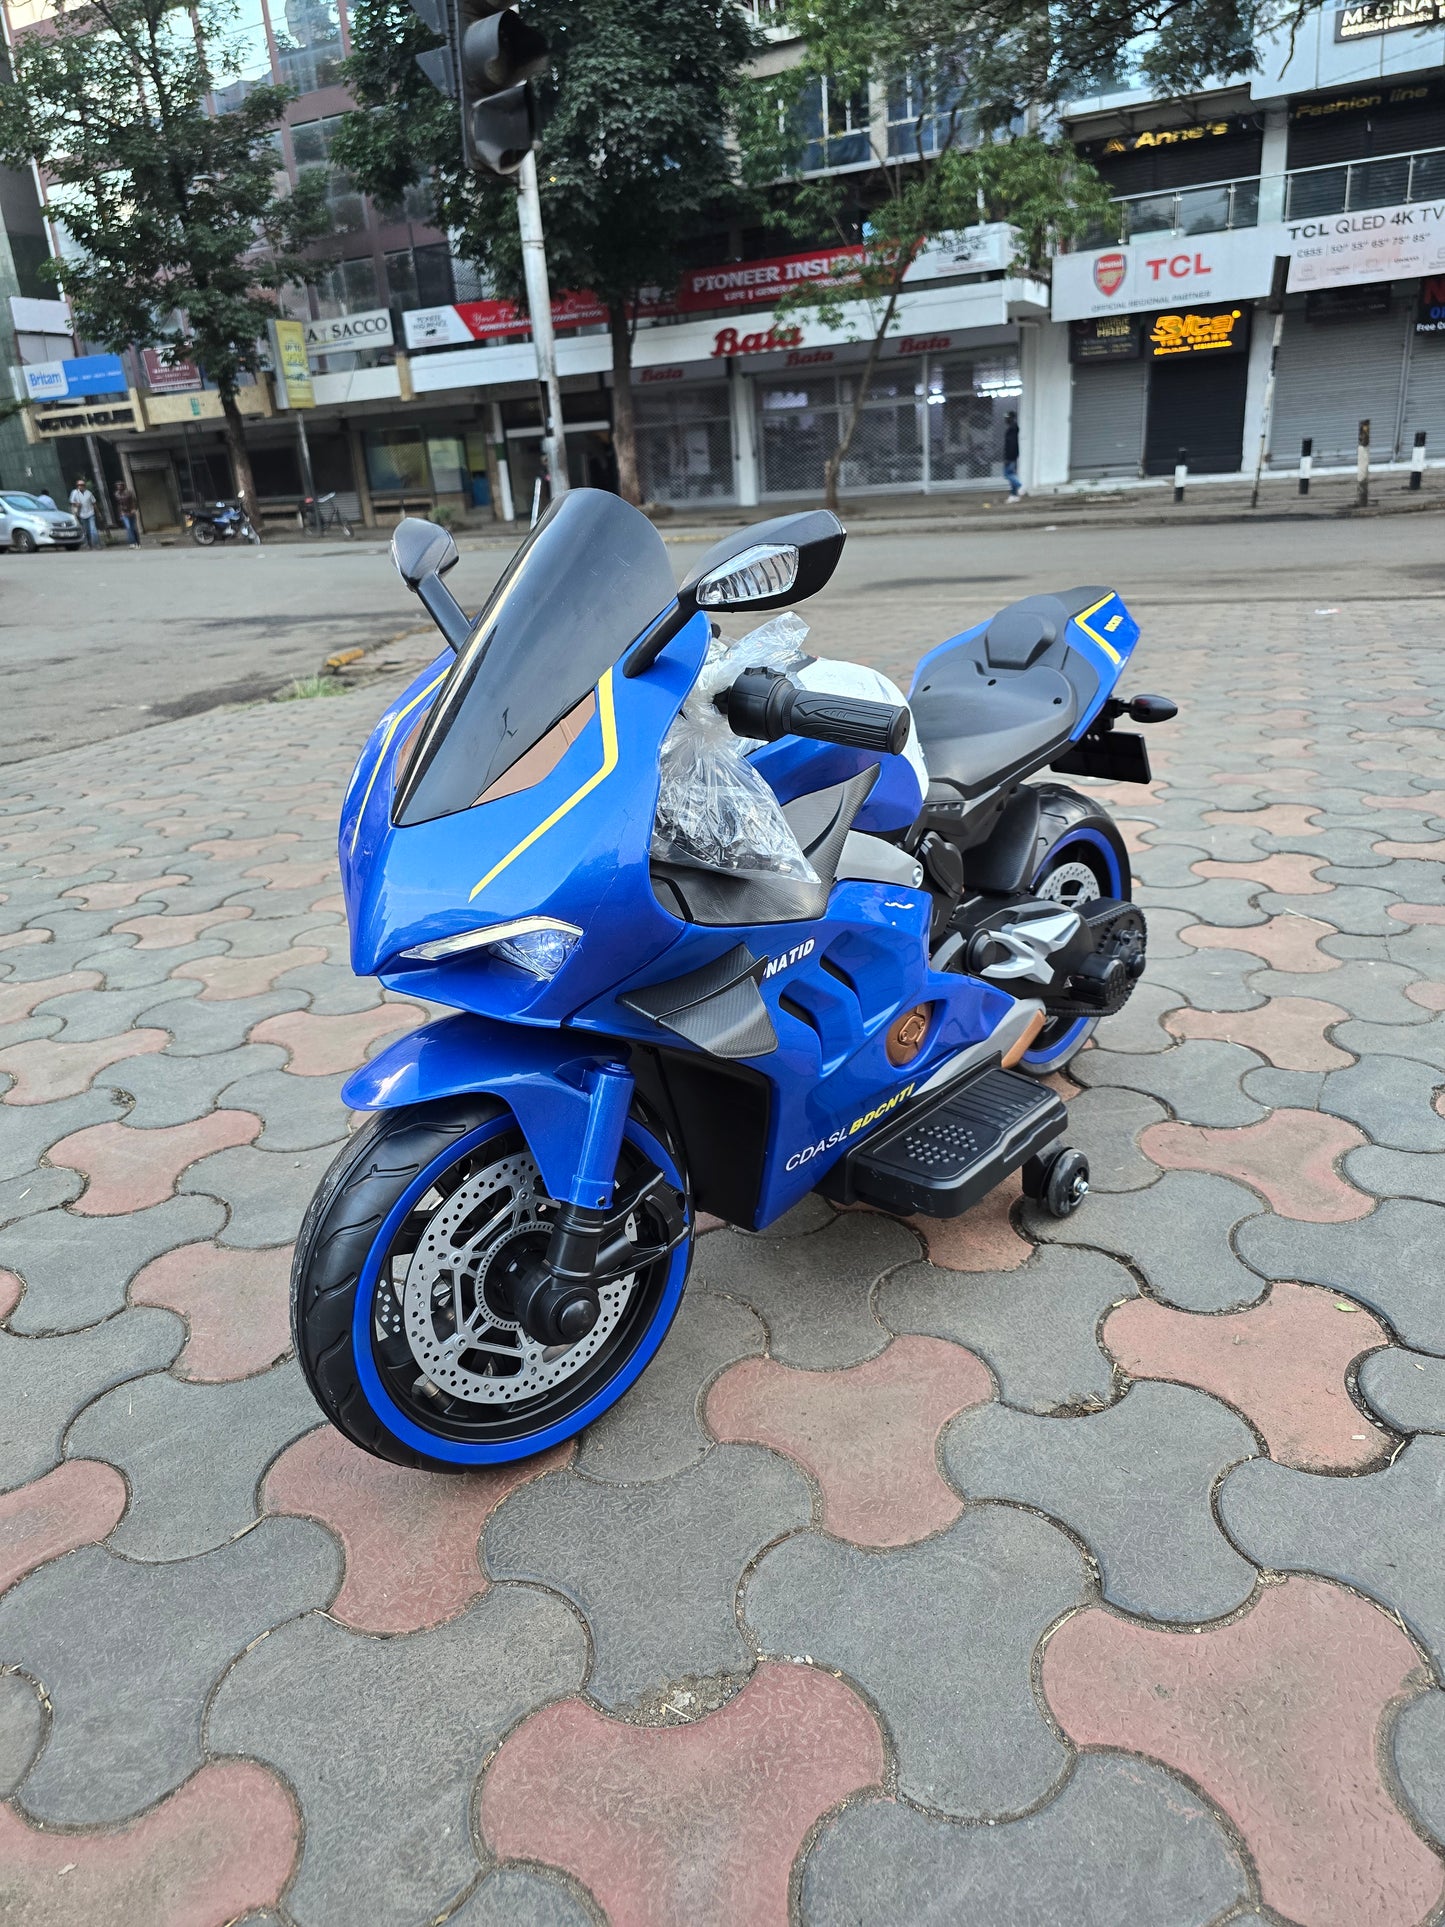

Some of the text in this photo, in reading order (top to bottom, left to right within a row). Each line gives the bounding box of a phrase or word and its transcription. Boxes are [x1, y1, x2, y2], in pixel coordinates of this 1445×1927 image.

[1296, 95, 1381, 119] Fashion
[1289, 206, 1445, 240] TCL QLED 4K TV
[1146, 253, 1212, 281] TCL
[693, 266, 780, 293] PIONEER
[332, 317, 388, 338] SACCO
[900, 336, 951, 354] Bata
[786, 350, 834, 367] Bata
[30, 373, 62, 387] Britam
[763, 939, 815, 979] NATID
